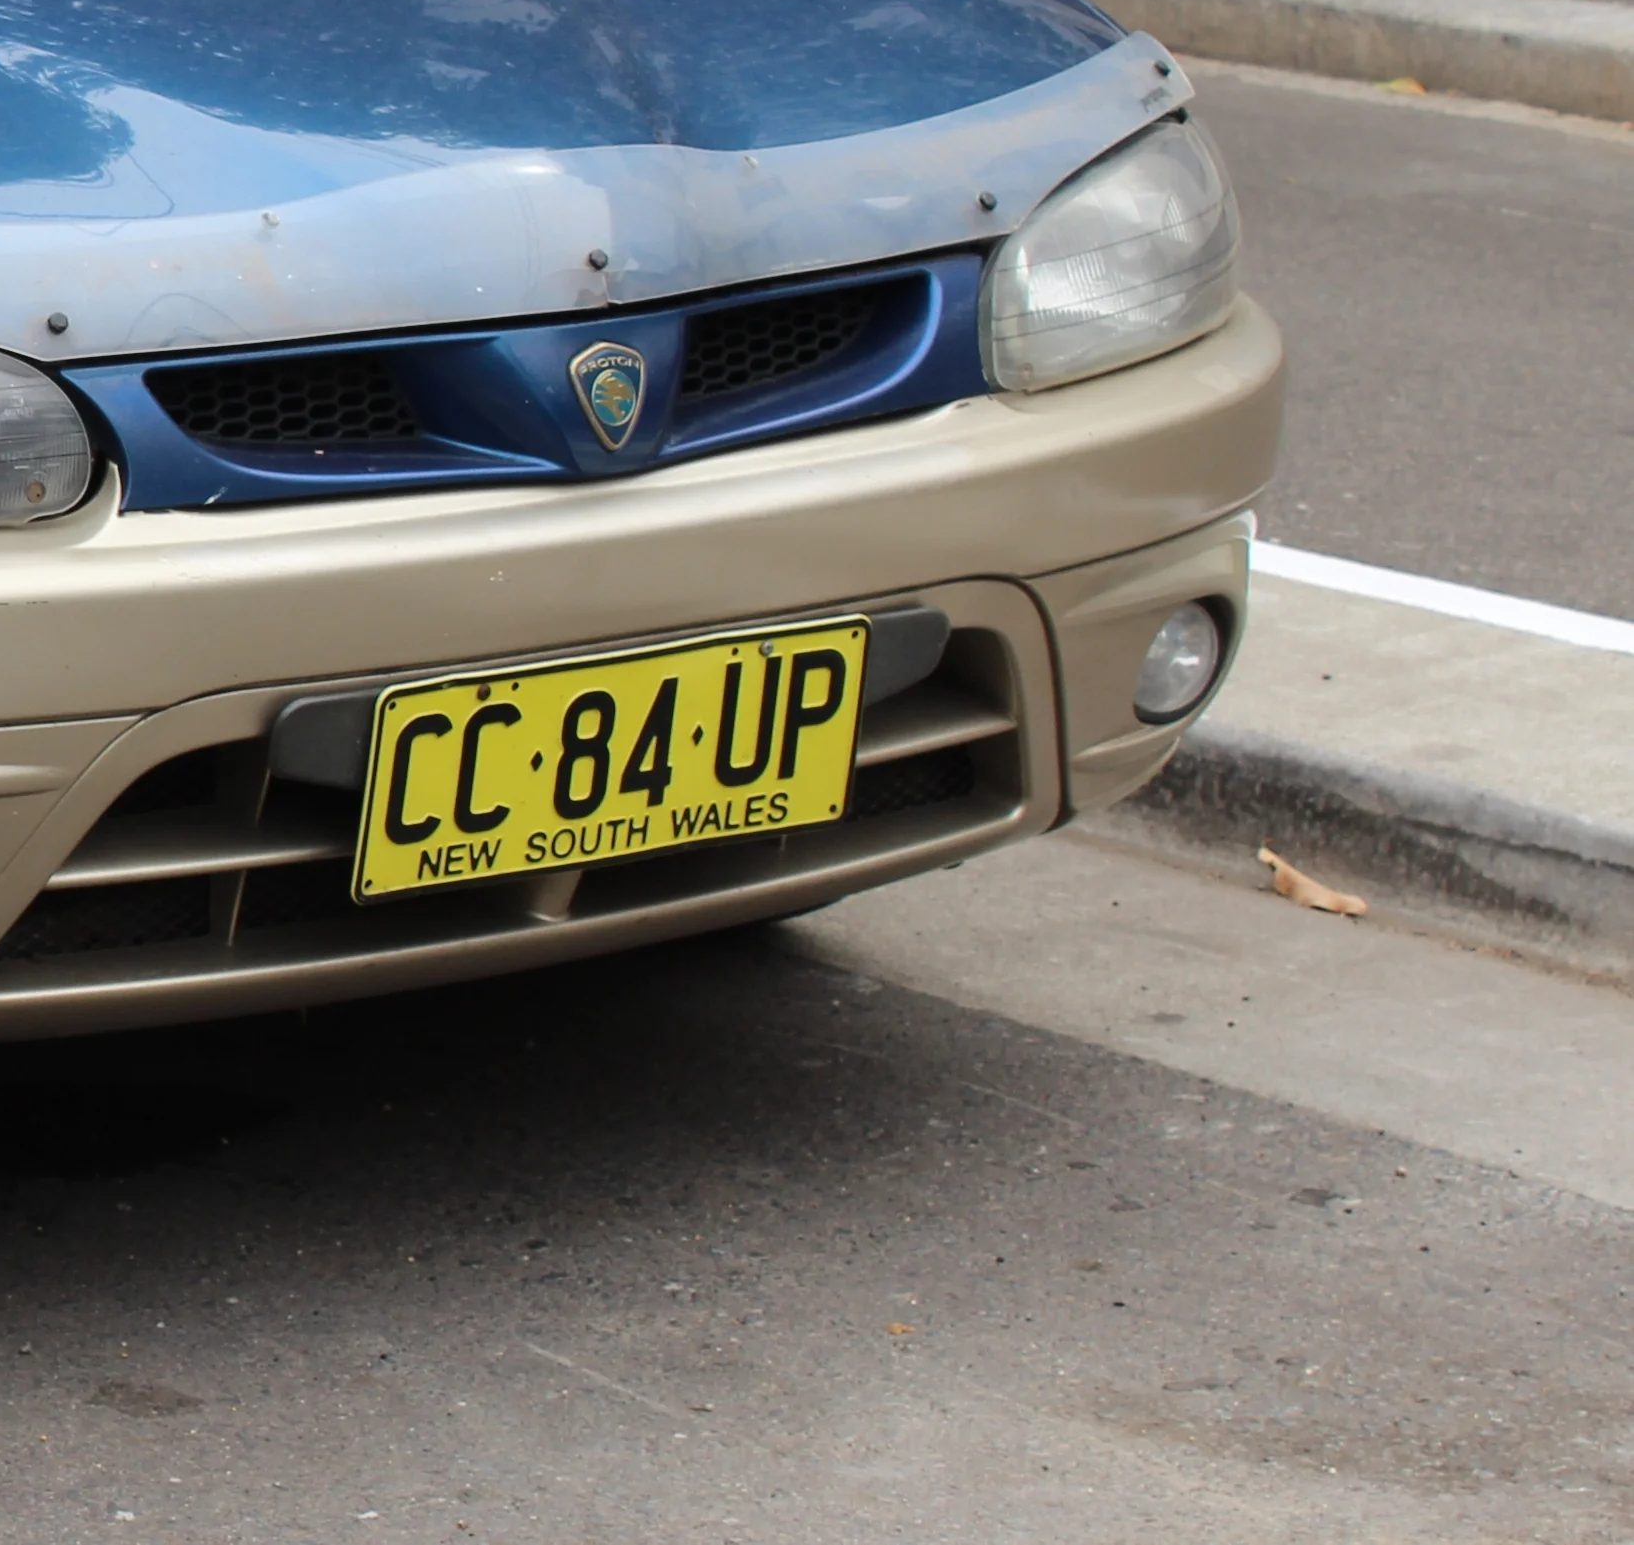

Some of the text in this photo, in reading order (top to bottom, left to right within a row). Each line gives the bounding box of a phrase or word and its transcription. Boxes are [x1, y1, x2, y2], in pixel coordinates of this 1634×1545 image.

[578, 355, 640, 377] PROTON
[417, 791, 789, 880] NEW SOUTH WALES
